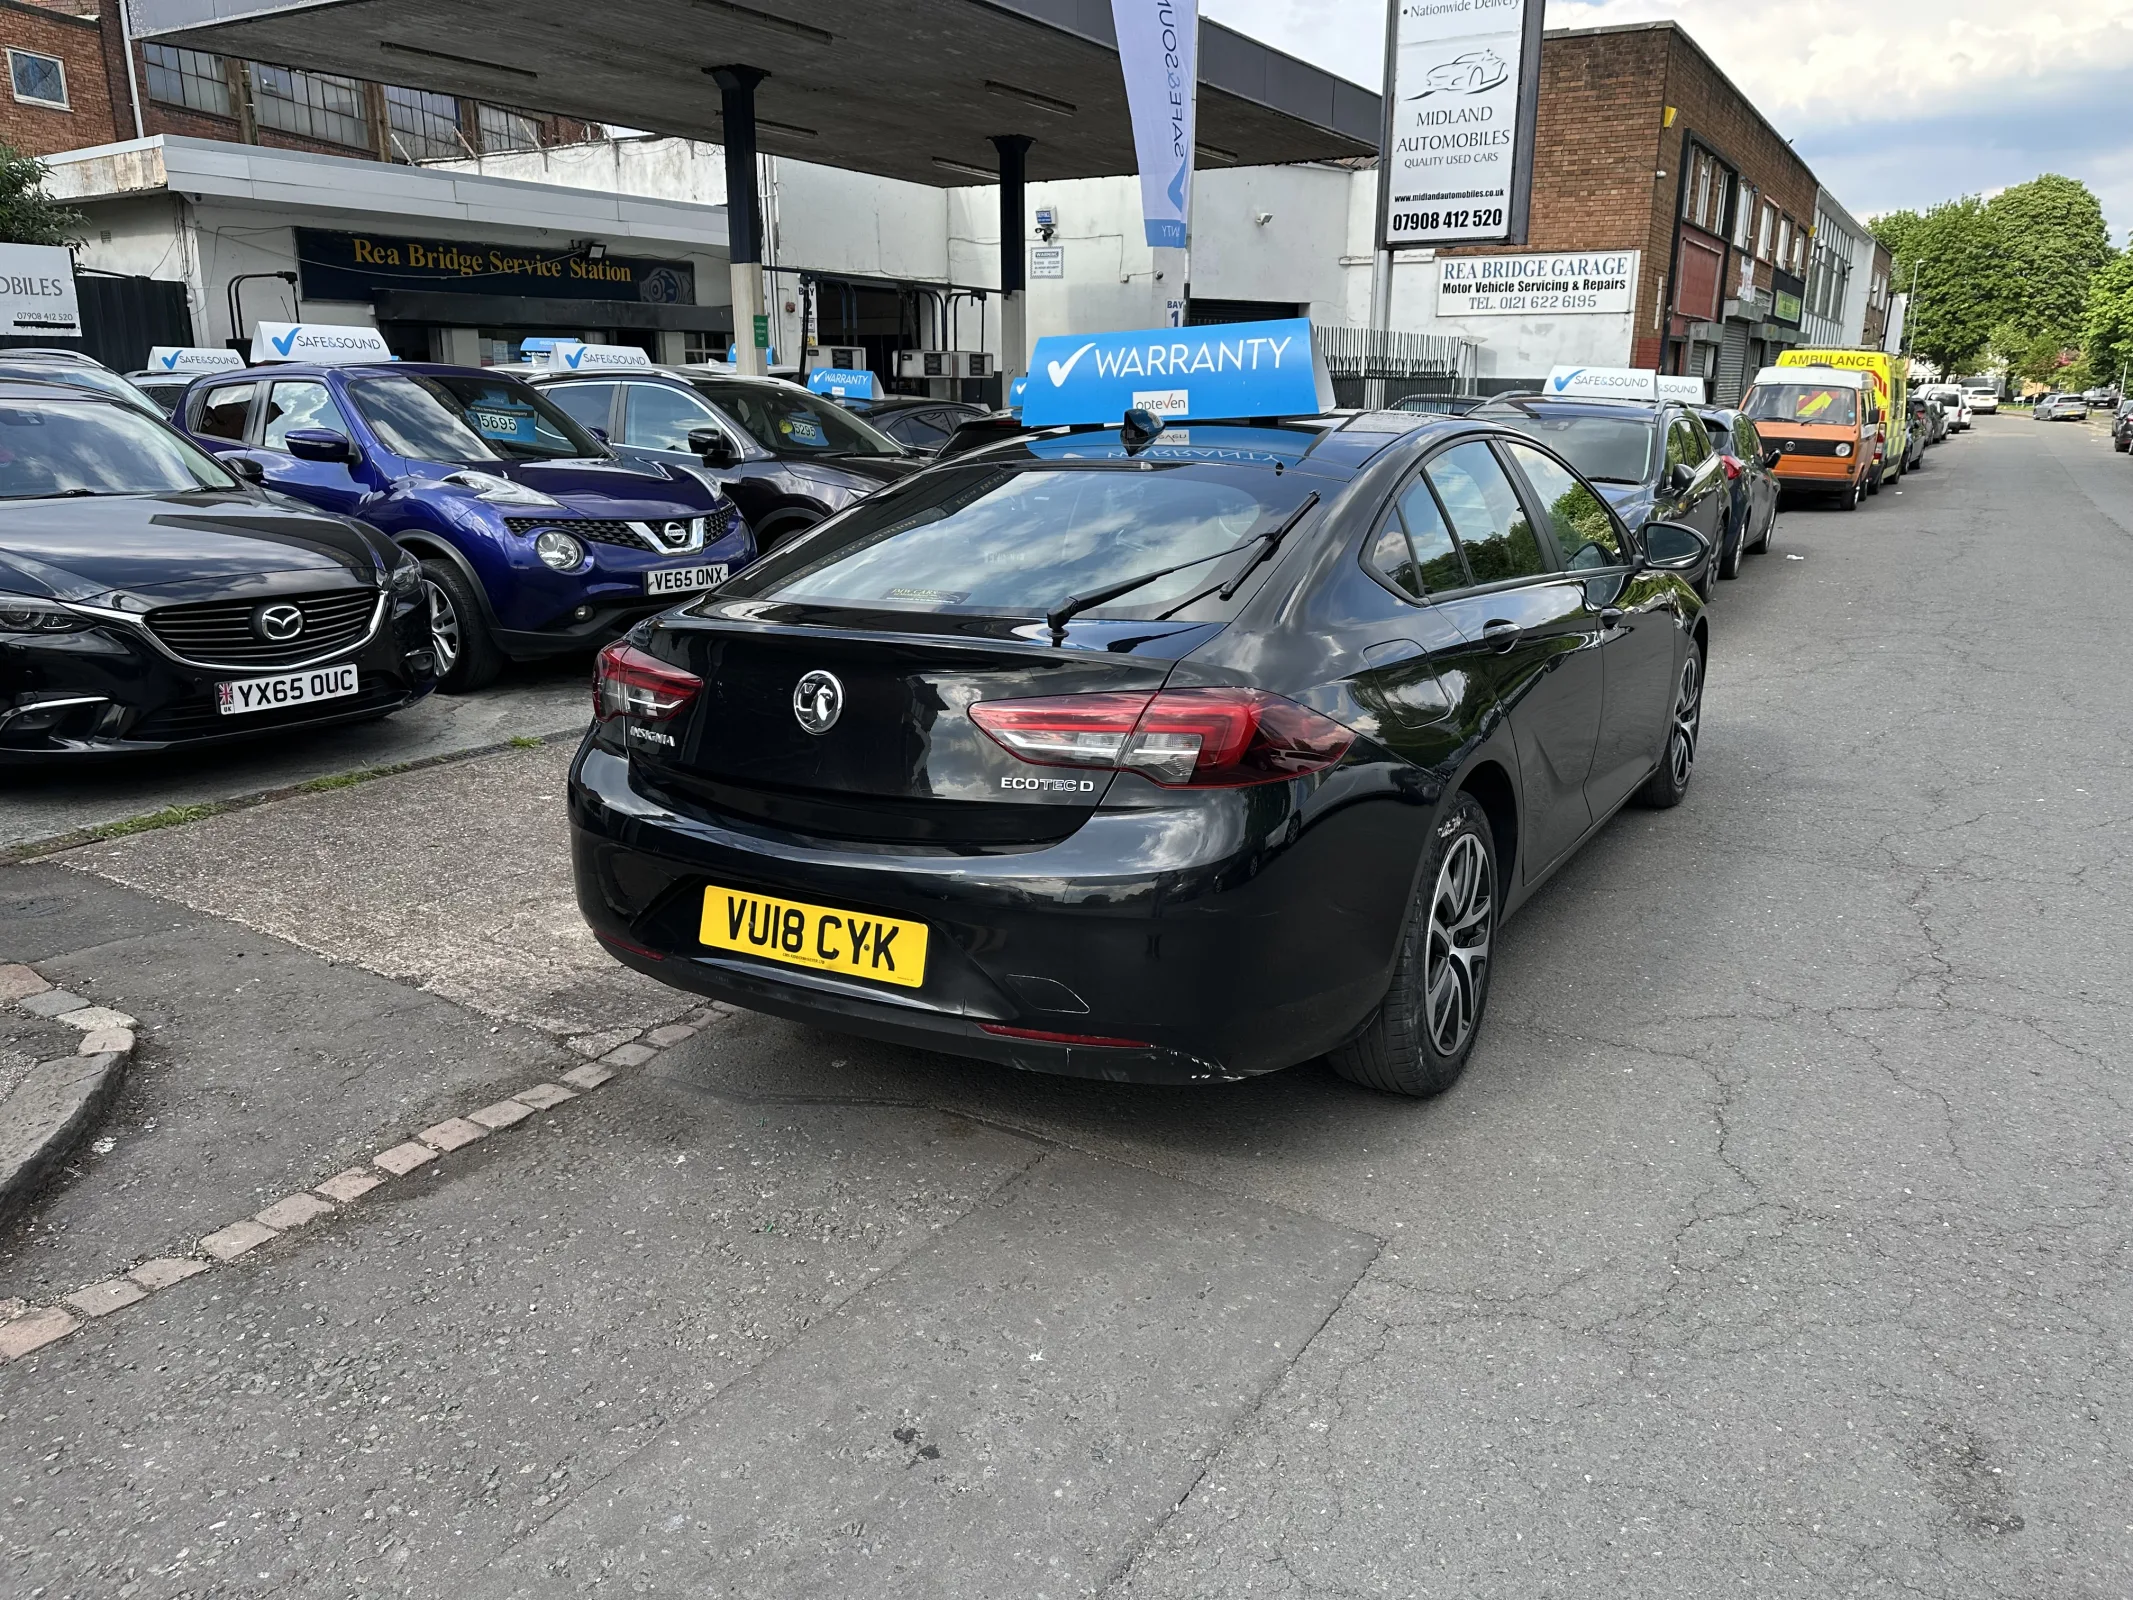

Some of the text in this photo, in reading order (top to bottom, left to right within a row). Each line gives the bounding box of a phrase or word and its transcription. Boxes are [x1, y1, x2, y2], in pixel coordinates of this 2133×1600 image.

[1410, 0, 1471, 18] Nationwide
[1416, 106, 1493, 127] MIDLAND
[1396, 129, 1511, 153] AUTOMOBILES
[1404, 152, 1499, 168] QUALITY USED CARS
[1394, 188, 1504, 202] www.midlandautomobiles.co.uk
[1393, 208, 1503, 231] 07908 412 520
[352, 238, 632, 282] Rea Bridge Service Station
[1444, 256, 1628, 279] REA BRIDGE GARAGE
[798, 287, 815, 296] BY
[1442, 278, 1626, 294] Motor Vehicle Servicing & Repairs
[1166, 301, 1184, 309] BAY
[1469, 294, 1597, 310] TEL. 0121 622 6195
[17, 312, 73, 321] 07908 412 520
[1170, 310, 1179, 328] 1
[296, 335, 381, 350] SAFE&SOUND
[178, 355, 240, 365] SAFE&SOUND
[583, 353, 647, 366] SAFE&SOUND
[1095, 336, 1292, 378] WARRANTY
[1788, 355, 1875, 367] AMBULANCE
[824, 372, 869, 385] WARRANTY
[1574, 375, 1649, 388] SAFE&SOUND
[480, 414, 517, 432] 5695
[793, 423, 816, 437] 5295
[654, 566, 723, 590] VE65 ONX
[238, 669, 354, 707] YX65 OUC
[223, 705, 232, 713] UK
[1001, 777, 1095, 792] ECOTEC D
[727, 896, 900, 972] VU18 CYK
